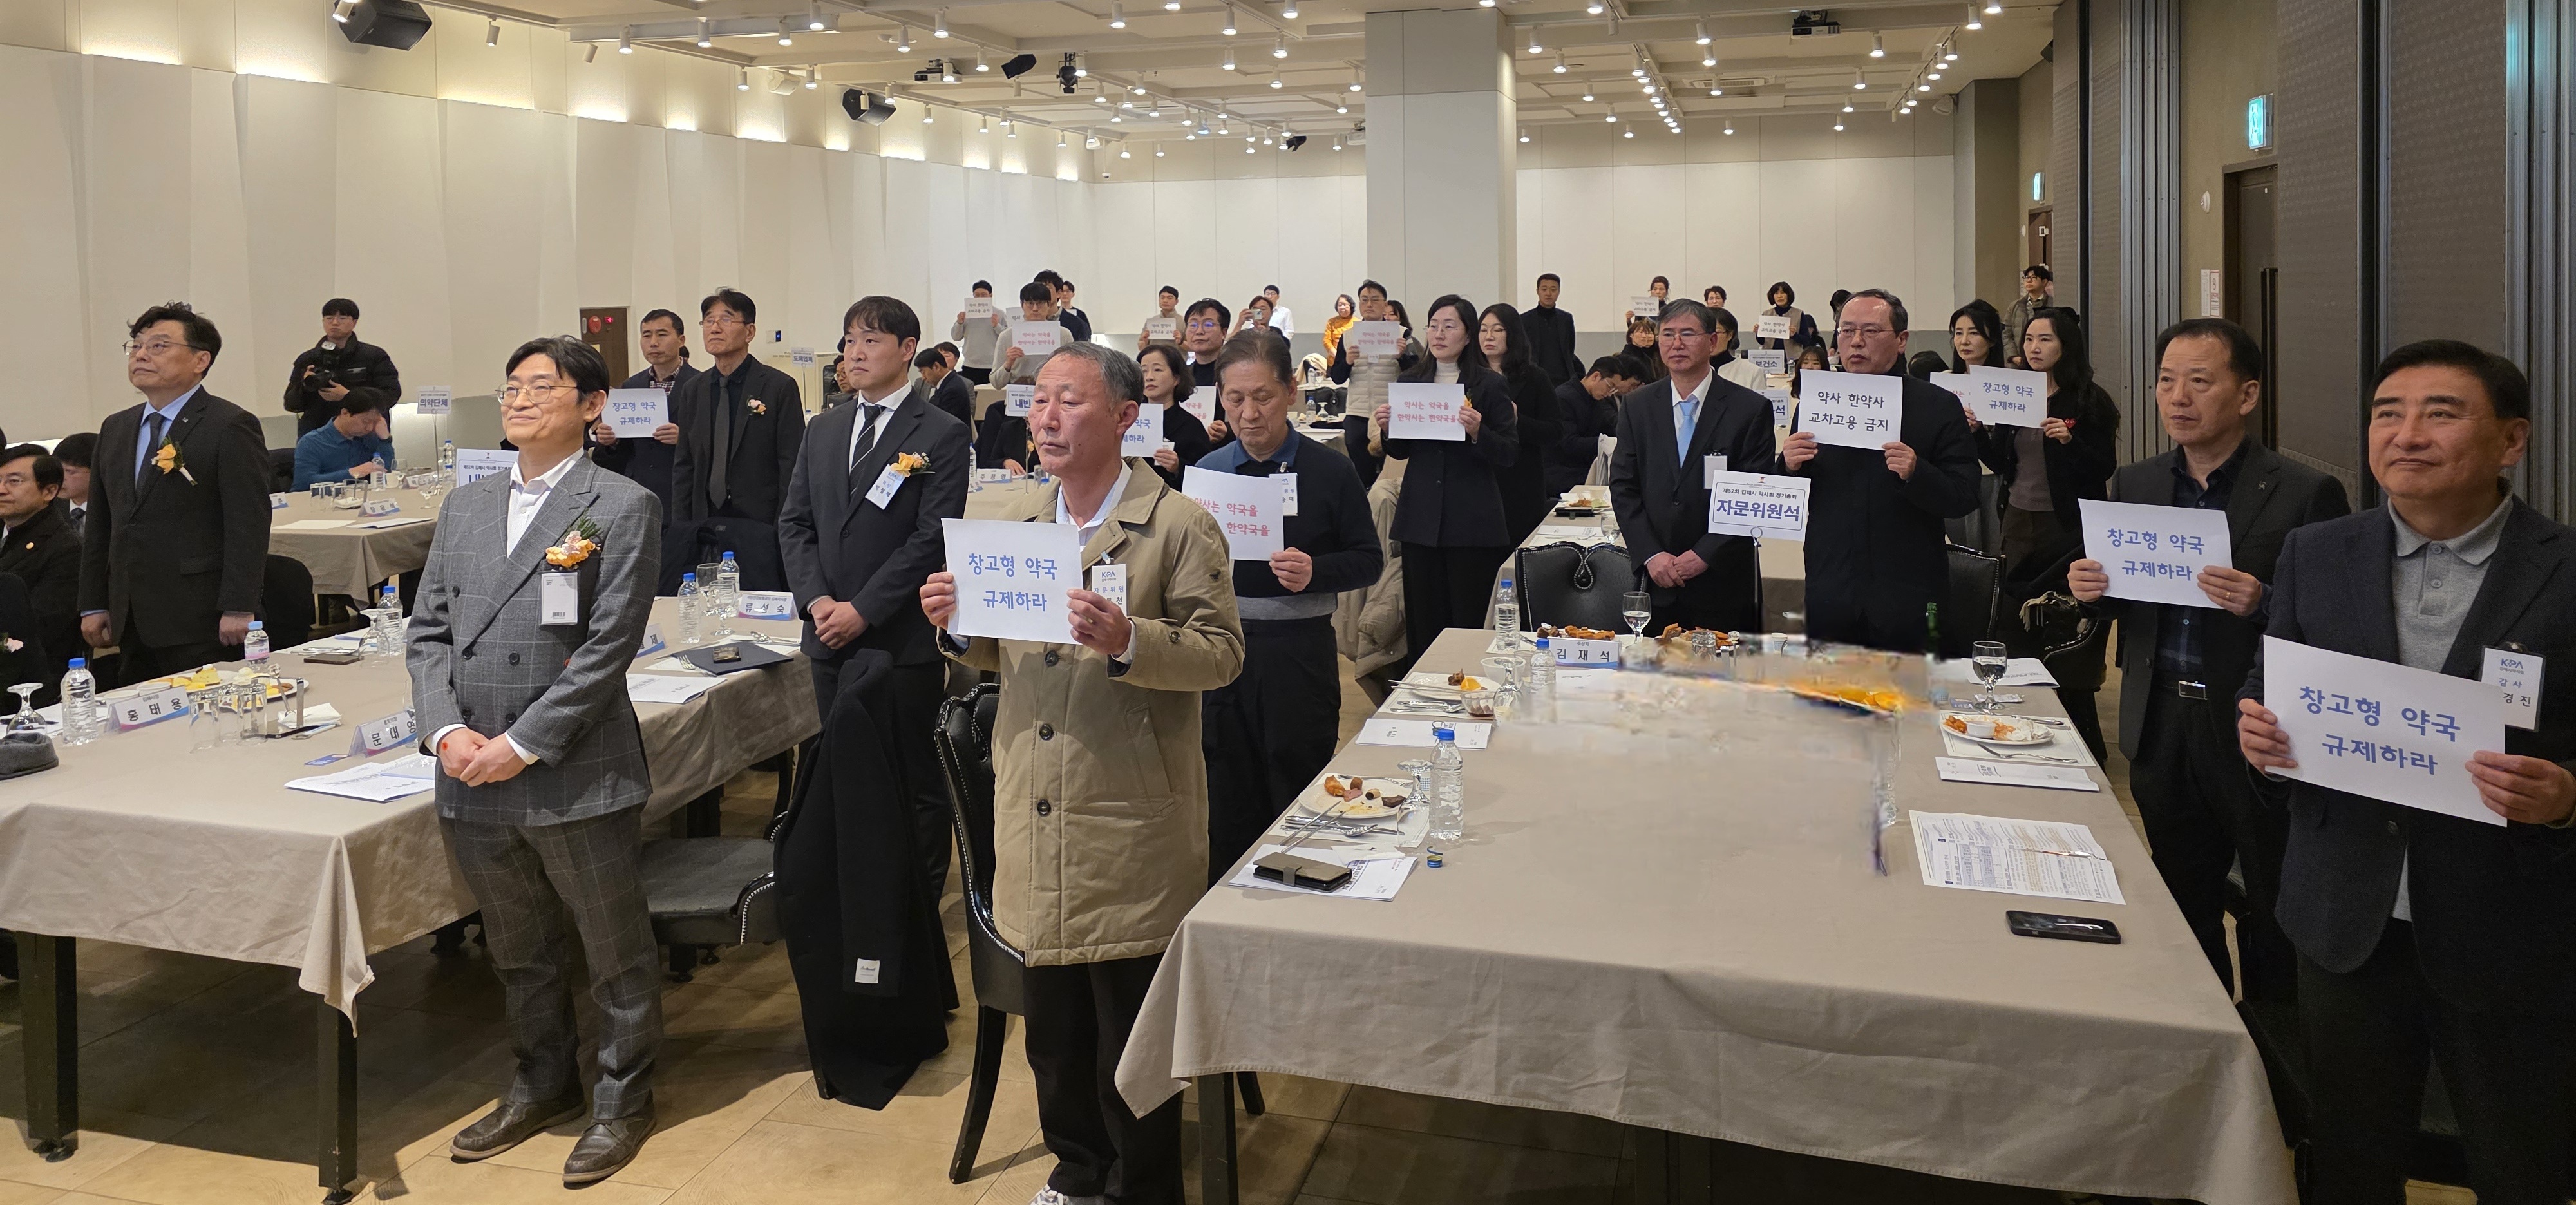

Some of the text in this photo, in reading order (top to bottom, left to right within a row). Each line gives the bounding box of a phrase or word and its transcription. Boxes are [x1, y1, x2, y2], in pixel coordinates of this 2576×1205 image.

[1982, 382, 2034, 397] 창고형 약국
[420, 398, 448, 407] 의약단체
[612, 402, 656, 412] 창고형 약국
[1404, 401, 1450, 410] 약사는 약국을
[1818, 391, 1885, 409] 약사 한약사
[1989, 400, 2026, 413] 규제하라
[620, 417, 651, 425] 규제하라
[1135, 419, 1151, 429] 약국
[1428, 414, 1457, 423] 한약국을
[1808, 412, 1888, 432] 교차고용 금지
[1226, 502, 1258, 517] 약국을
[1716, 500, 1800, 522] 자문위원석
[1226, 522, 1270, 536] 한약국을
[2107, 528, 2205, 555] 창고형 약국
[968, 553, 1057, 580] 창고형 약국
[2122, 560, 2192, 581] 규제하라
[983, 590, 1047, 612] 규제하라
[2501, 658, 2524, 670] KPA
[2299, 686, 2461, 742] 창고형 약국
[2322, 734, 2438, 775] 규제하라
